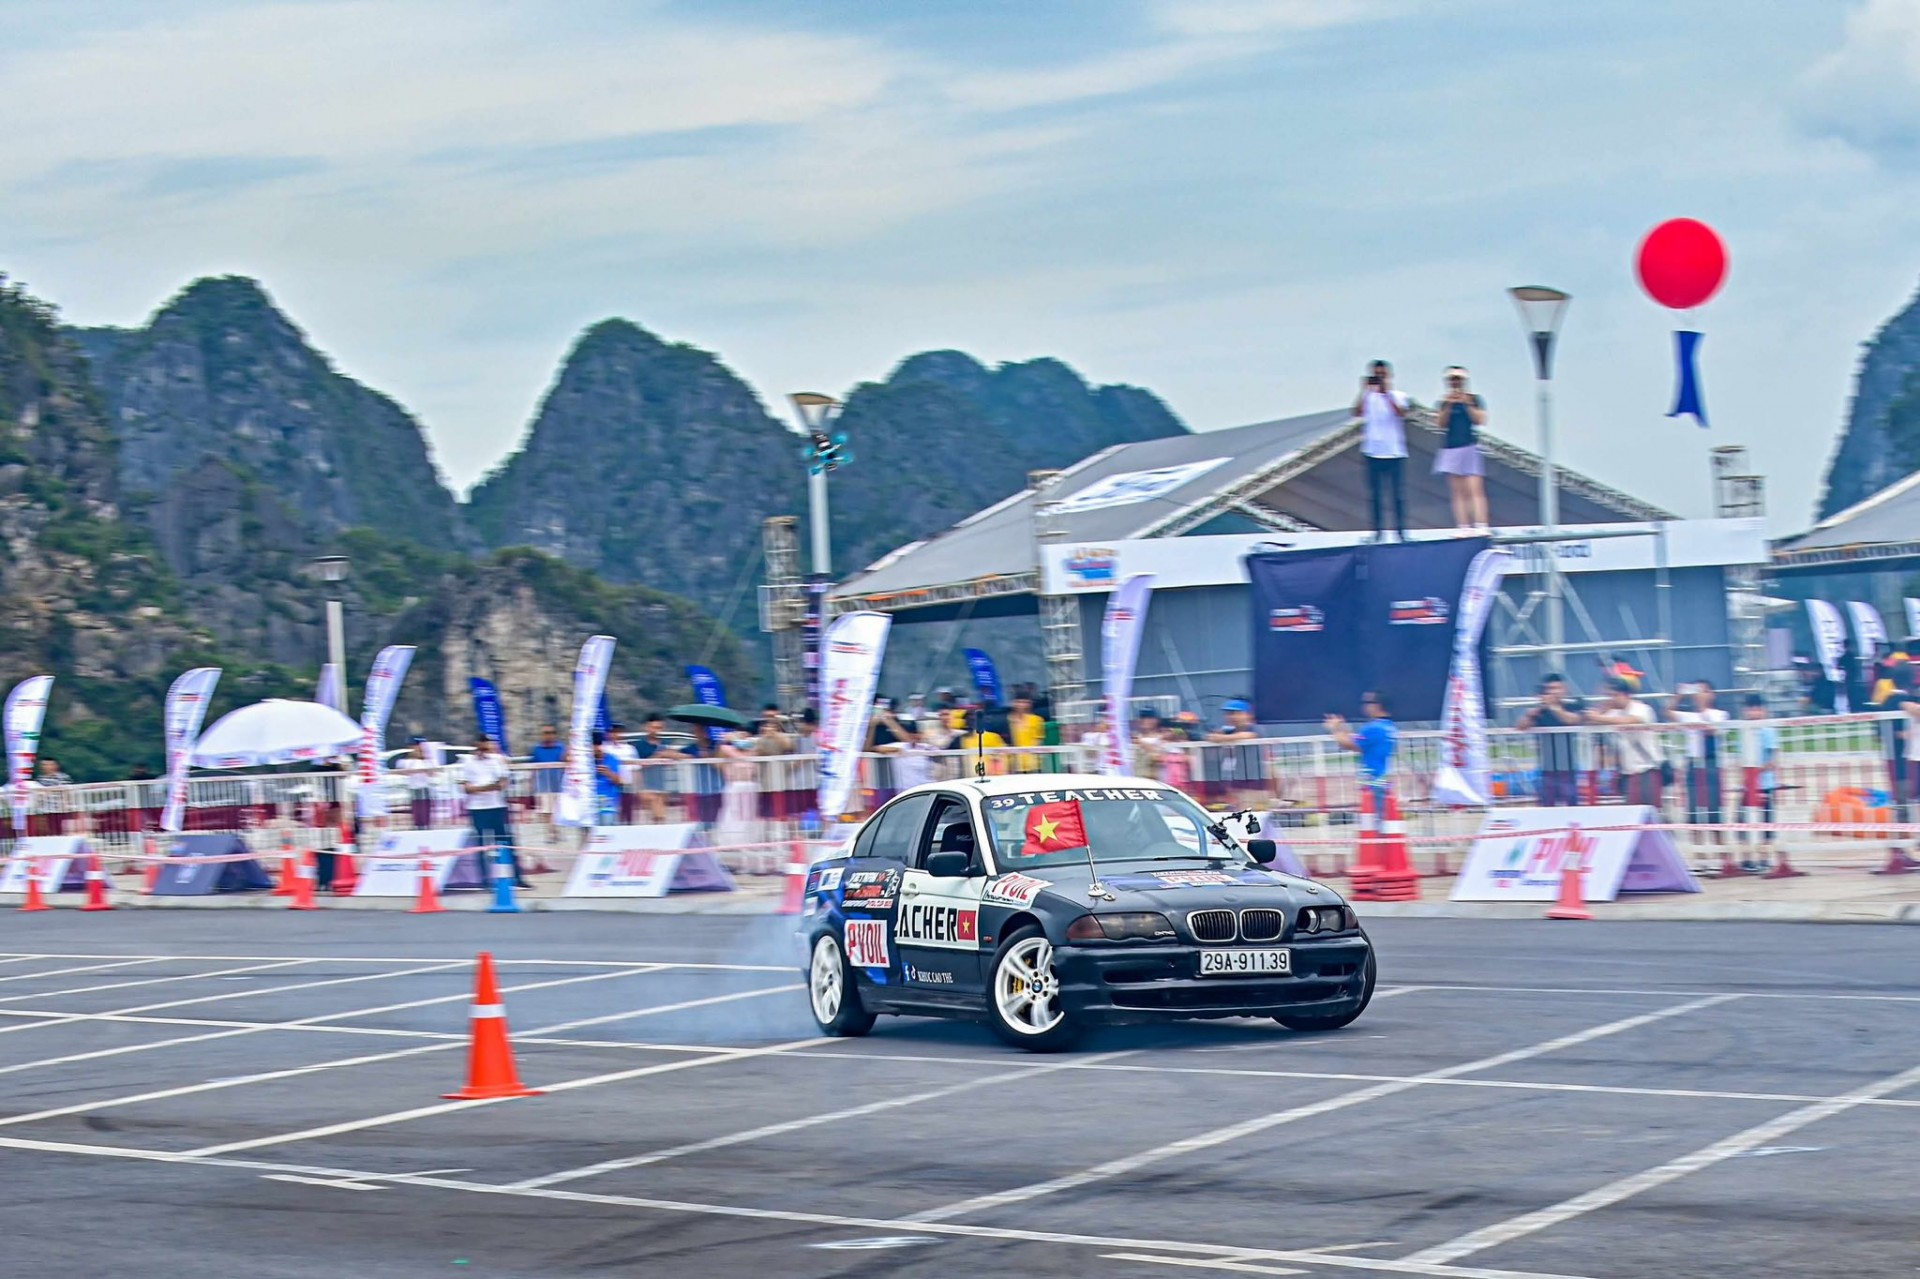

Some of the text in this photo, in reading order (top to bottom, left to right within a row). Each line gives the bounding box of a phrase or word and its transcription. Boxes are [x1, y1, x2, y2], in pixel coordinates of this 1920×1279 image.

[991, 789, 1163, 809] 39 TEACHER
[894, 904, 957, 942] ACHER
[848, 923, 886, 964] PVOIL
[1204, 952, 1288, 971] 29A-911.39
